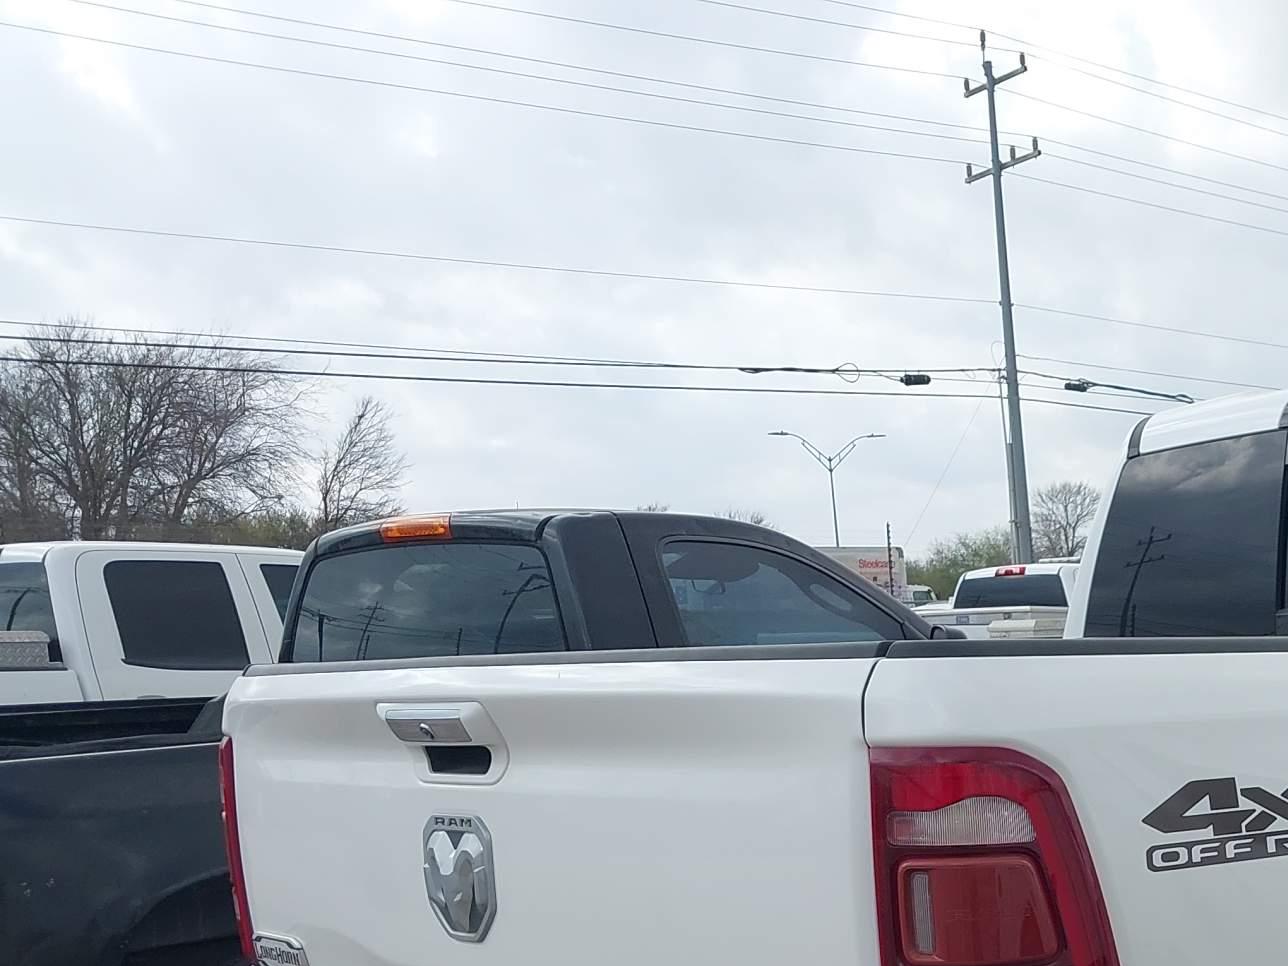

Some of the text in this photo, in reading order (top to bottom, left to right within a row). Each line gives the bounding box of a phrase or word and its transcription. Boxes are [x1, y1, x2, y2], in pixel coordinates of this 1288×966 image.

[858, 558, 896, 569] Steelcae
[434, 816, 473, 828] RAM
[1151, 837, 1257, 868] OFF
